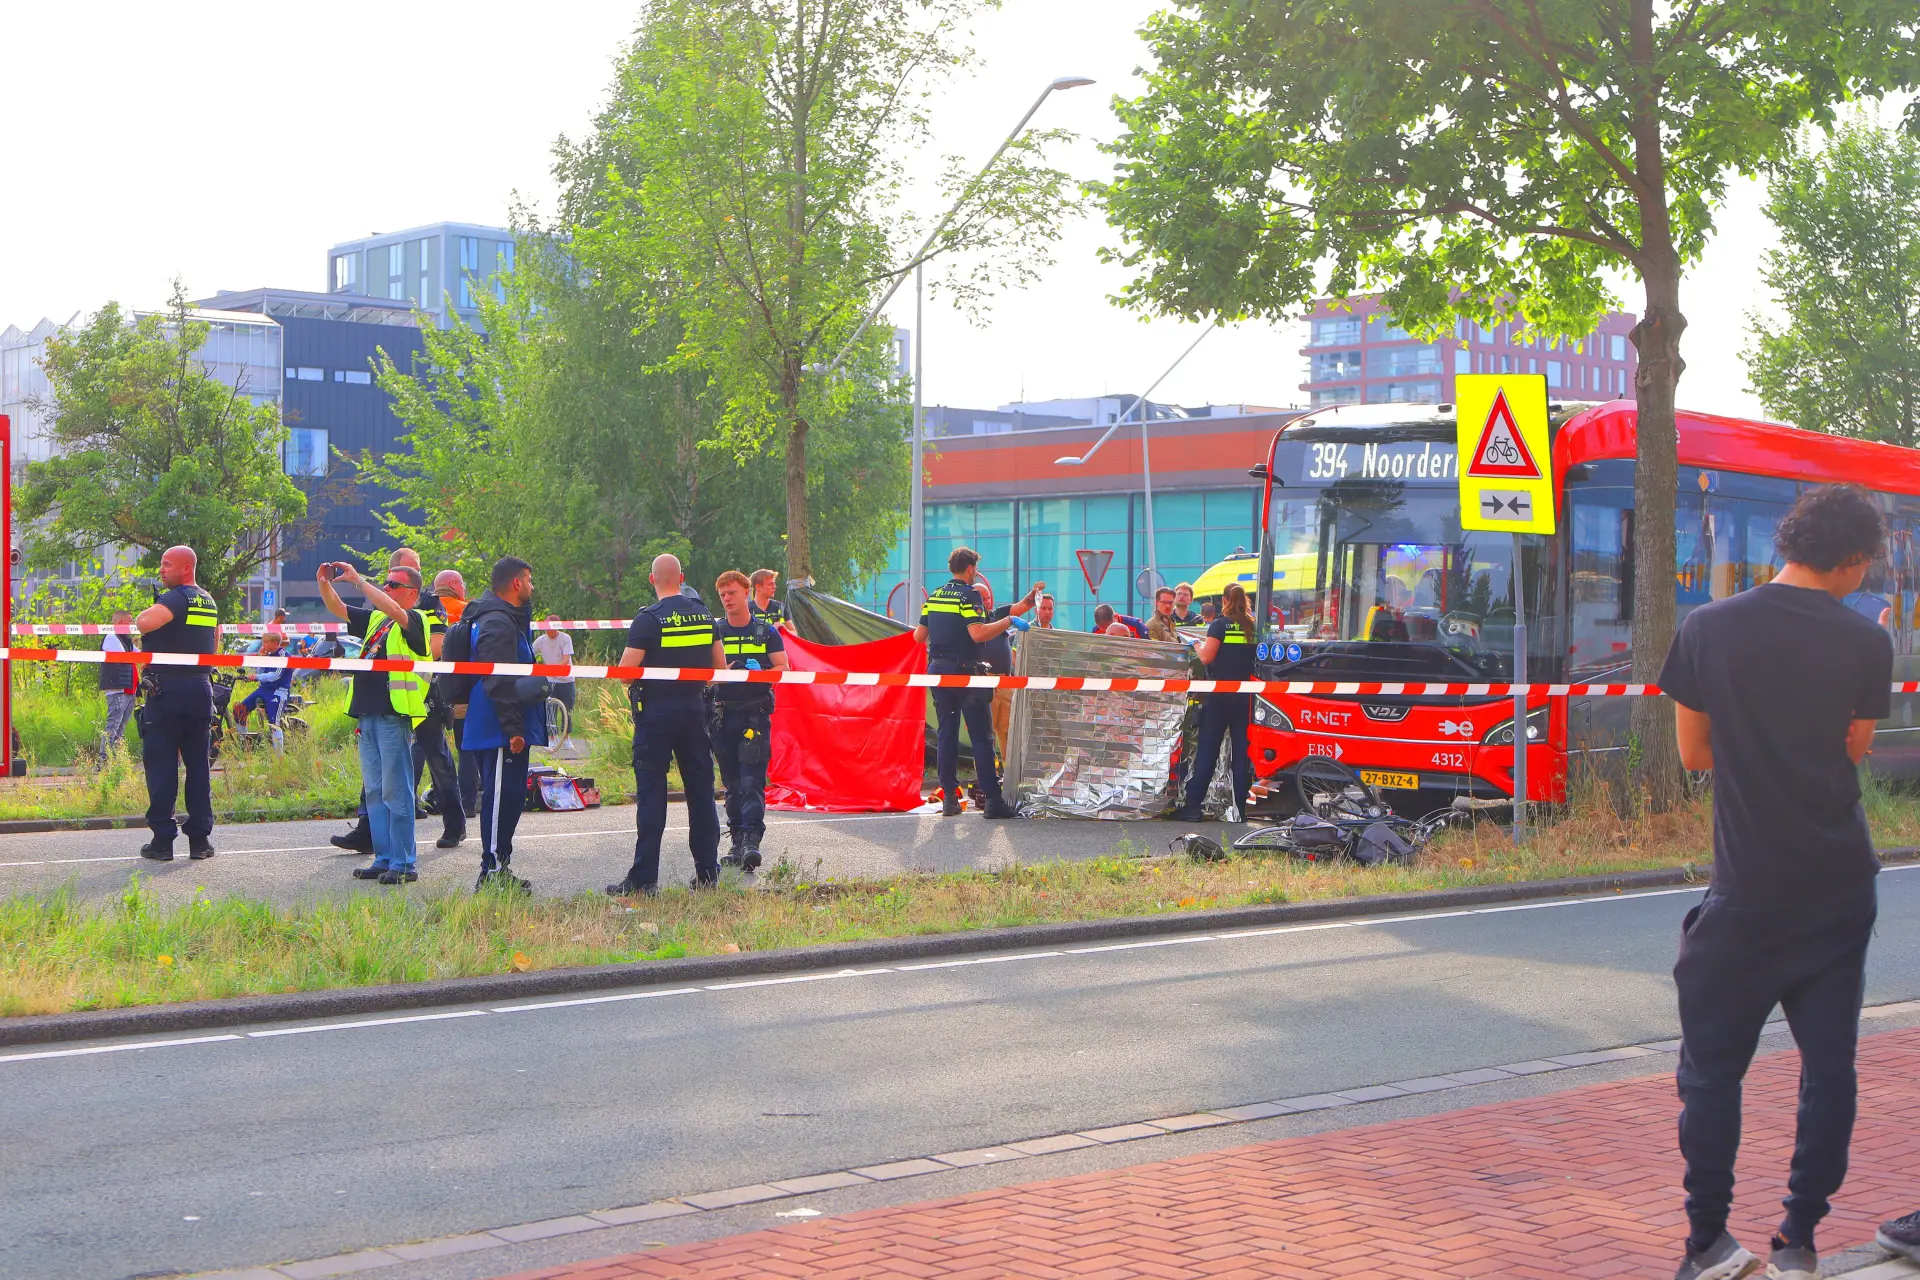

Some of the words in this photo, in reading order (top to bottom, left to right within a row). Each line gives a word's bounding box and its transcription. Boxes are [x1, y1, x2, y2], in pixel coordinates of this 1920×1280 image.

[1309, 442, 1348, 478] 394
[1362, 442, 1459, 478] Noorder
[666, 611, 707, 627] POLITIE
[1368, 706, 1401, 717] VDL
[1308, 743, 1334, 758] EBS
[1431, 752, 1464, 767] 4312
[1364, 772, 1414, 788] 27-BXZ-4
